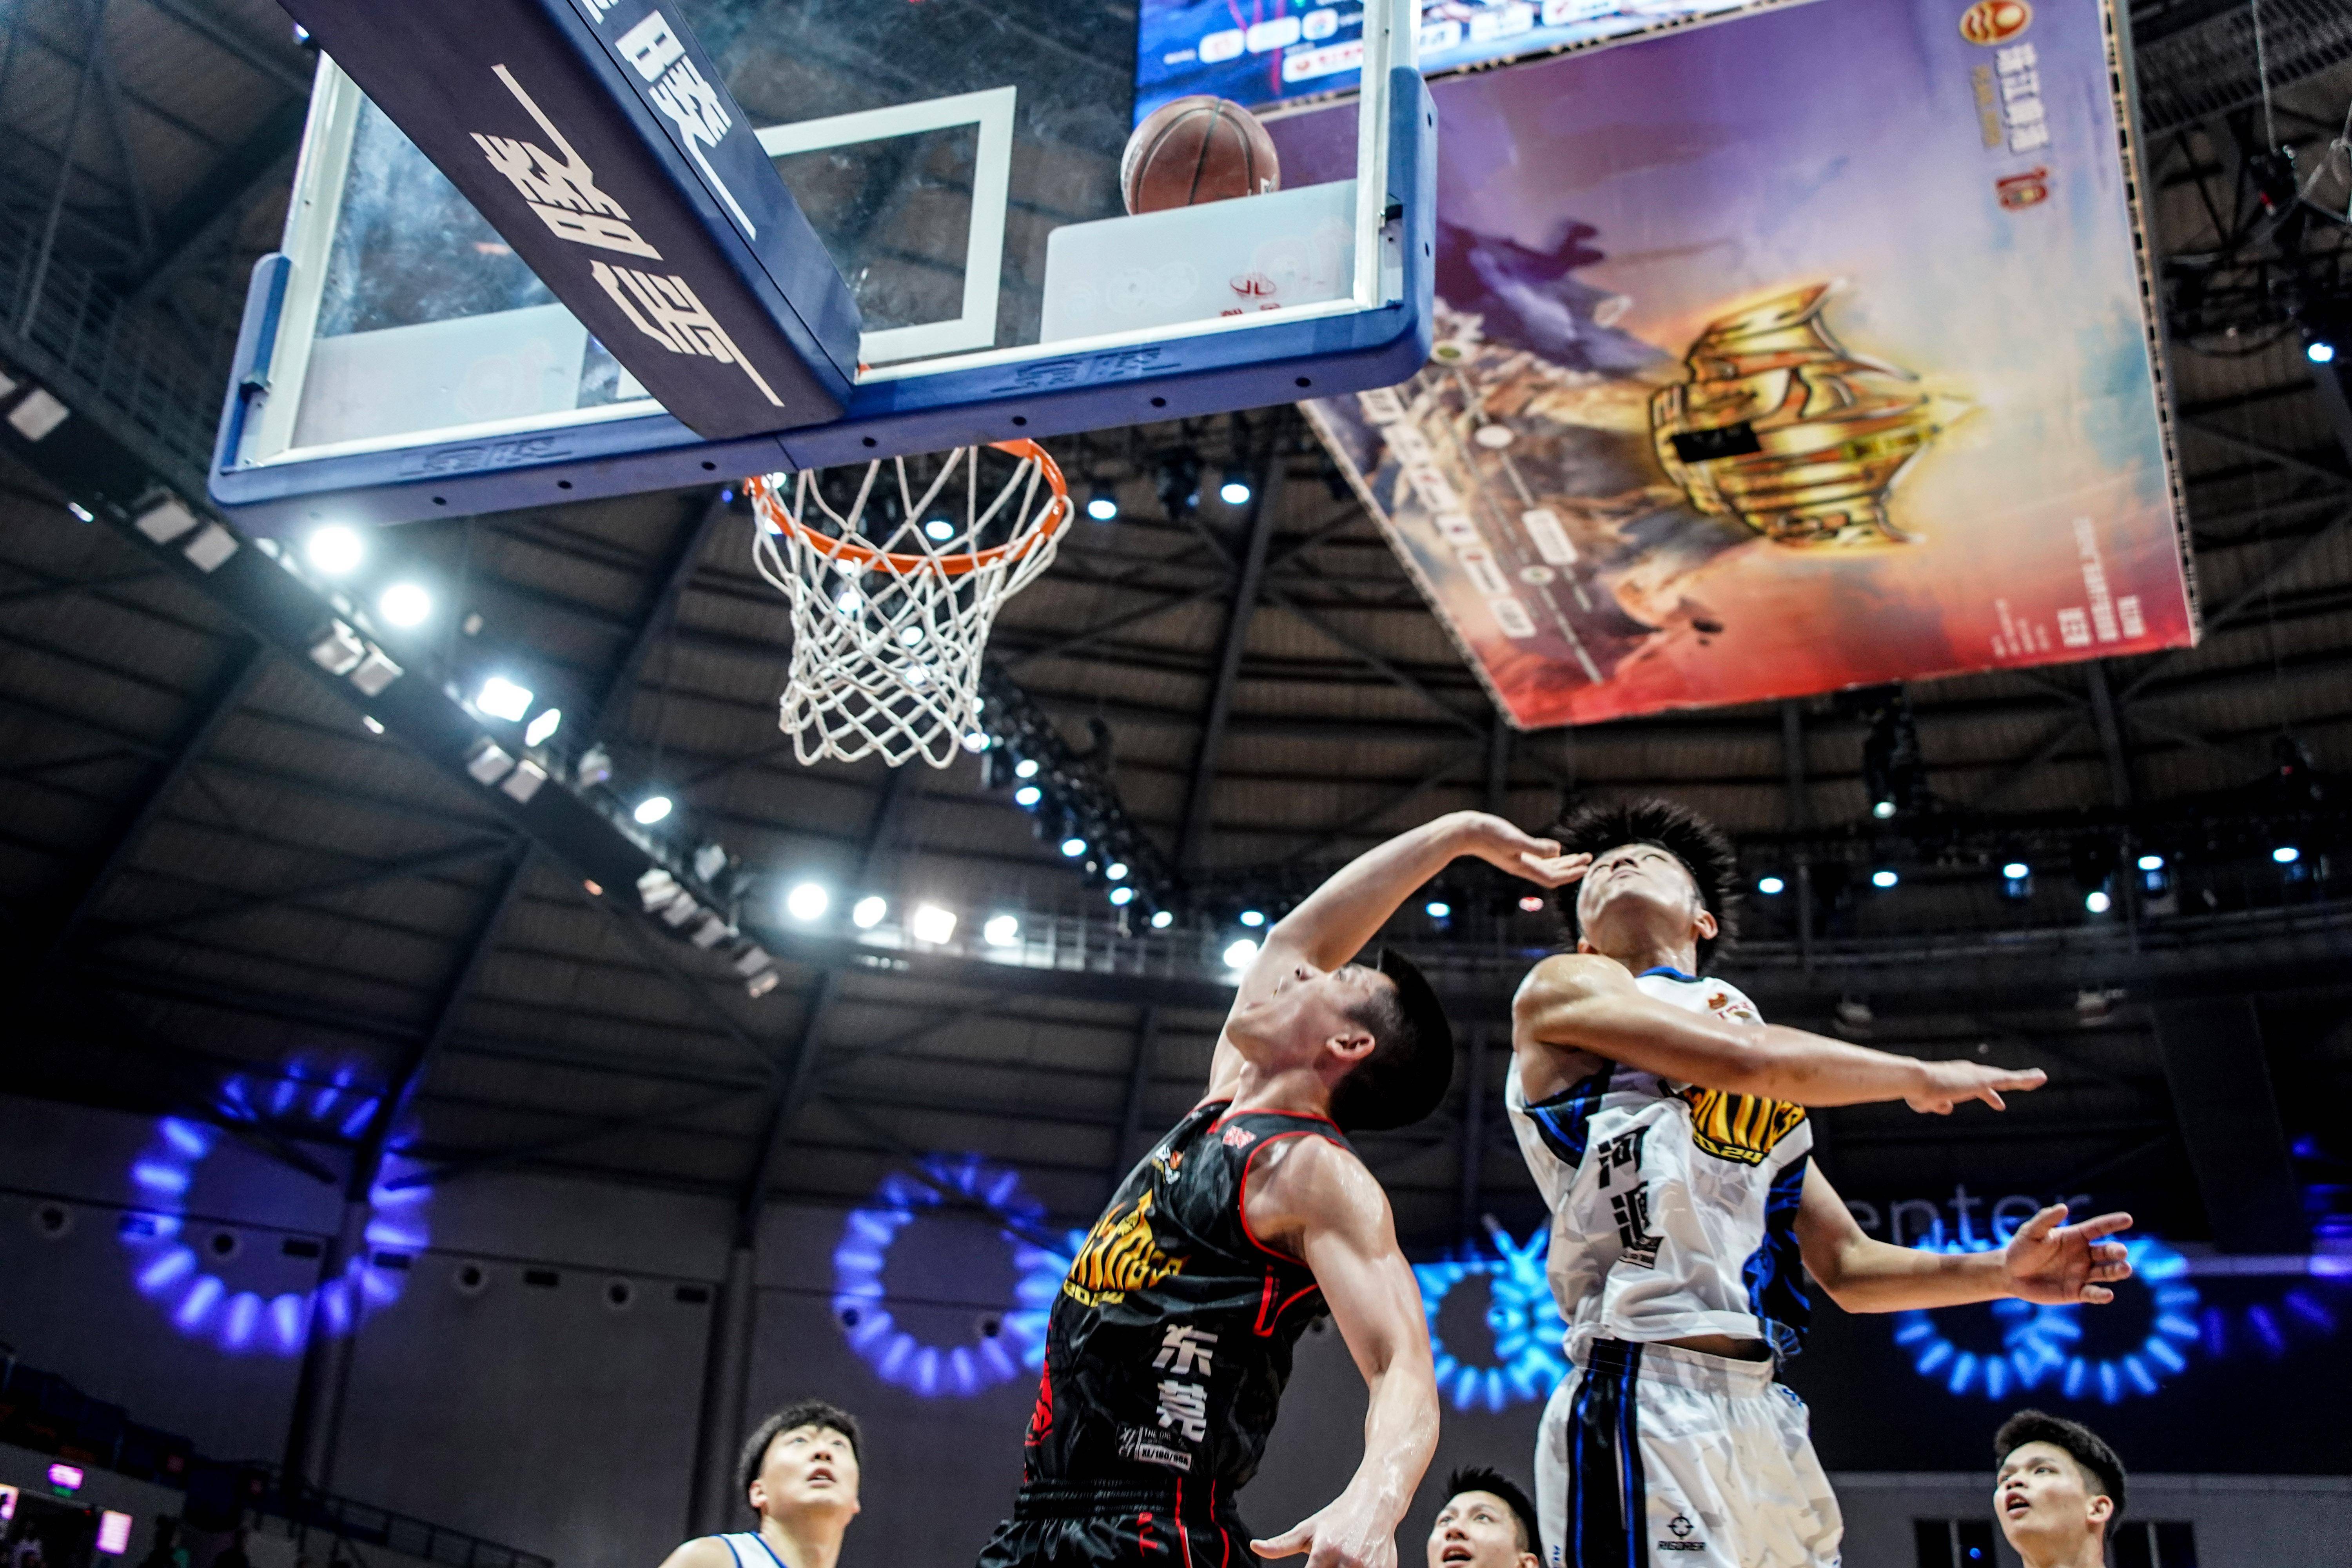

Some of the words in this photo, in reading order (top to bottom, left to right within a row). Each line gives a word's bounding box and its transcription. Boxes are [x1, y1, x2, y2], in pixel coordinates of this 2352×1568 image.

[581, 0, 757, 241] 陵
[470, 64, 785, 407] 金陵
[1692, 1126, 1764, 1160] 024
[1152, 1323, 1218, 1443] 东莞
